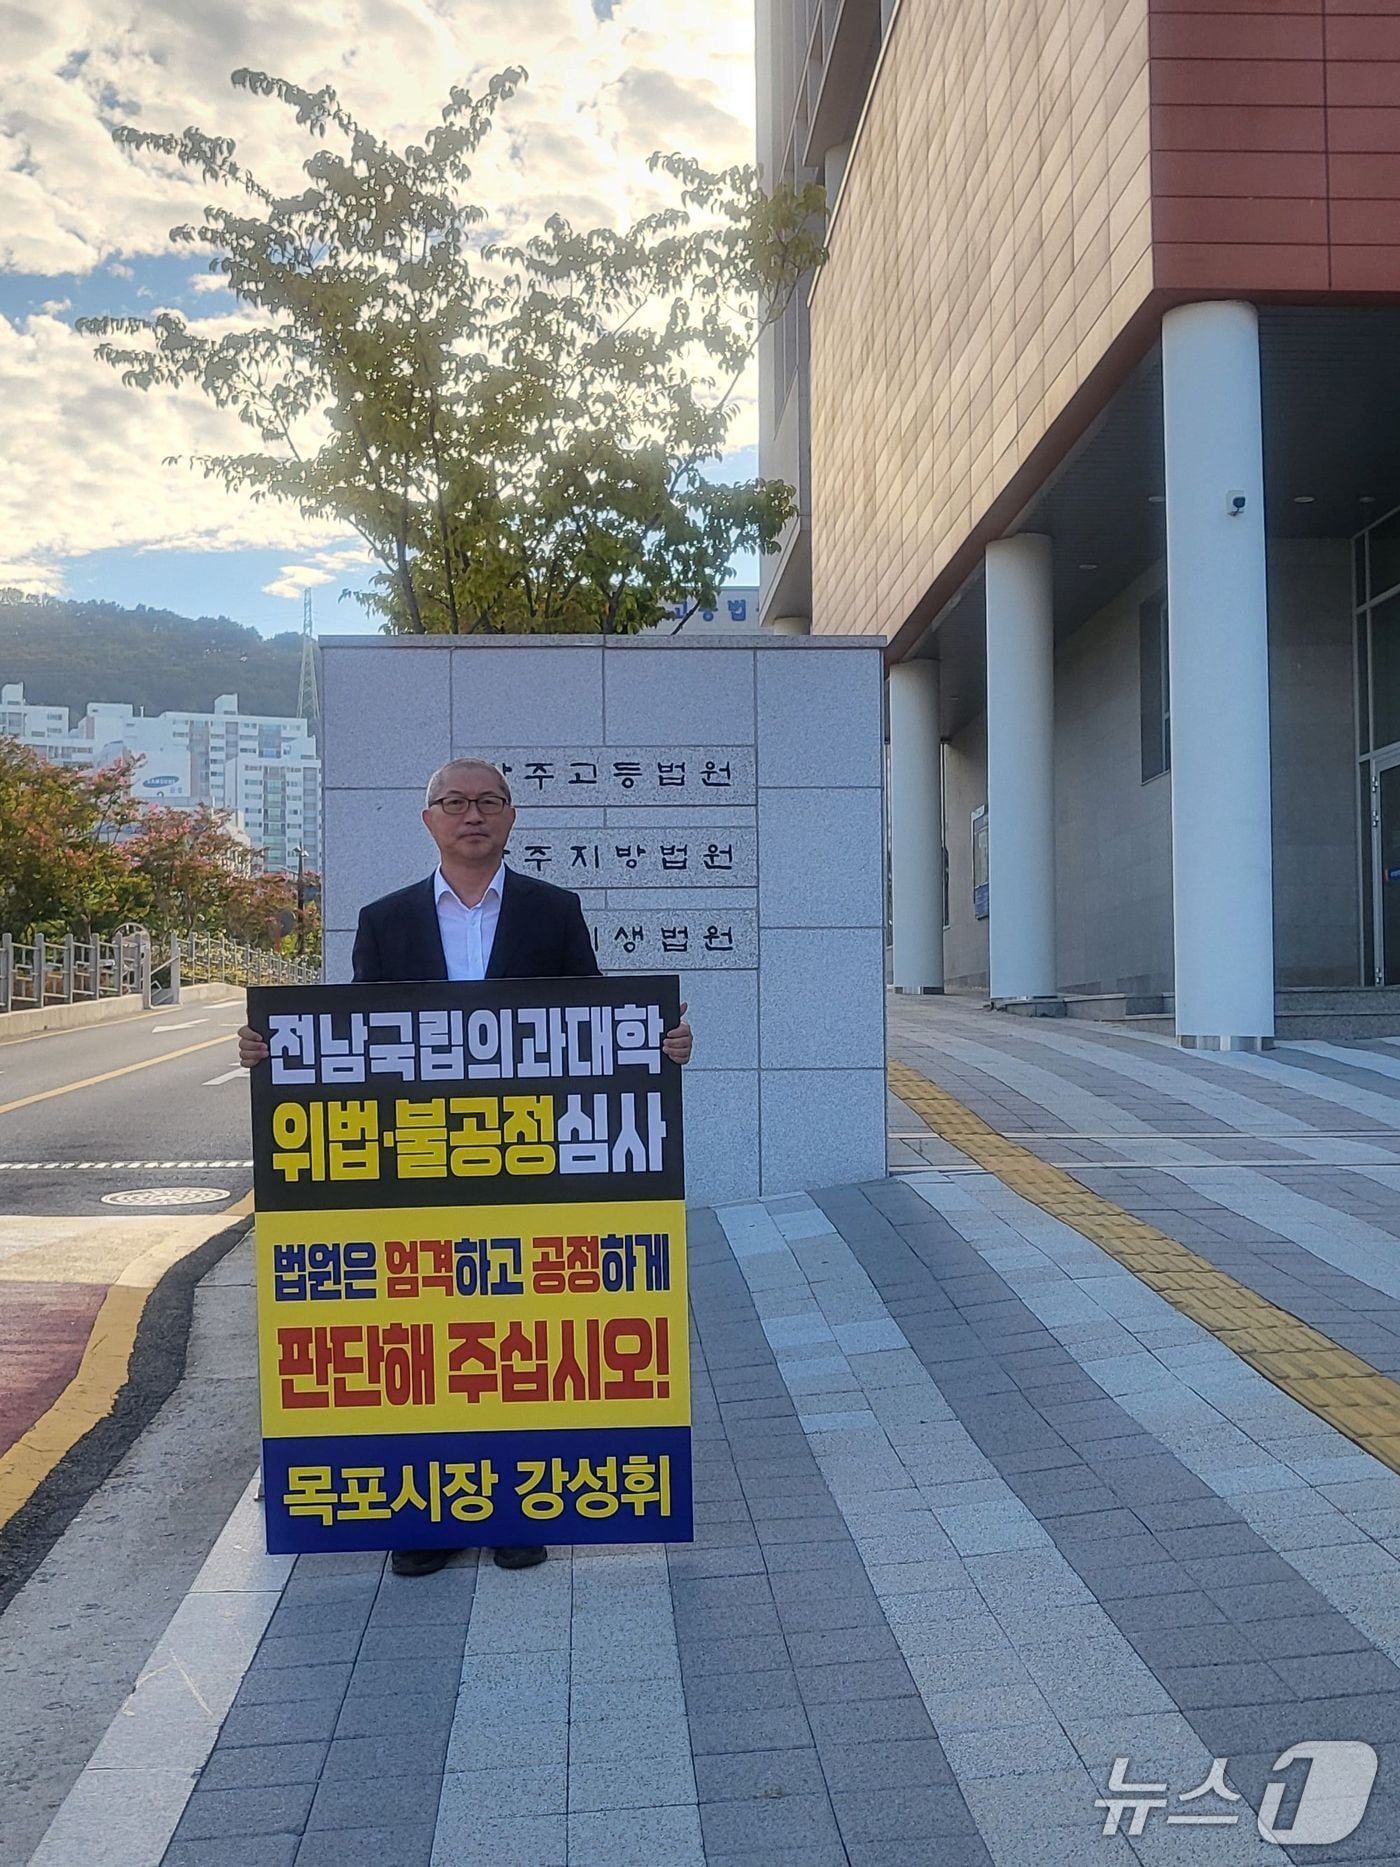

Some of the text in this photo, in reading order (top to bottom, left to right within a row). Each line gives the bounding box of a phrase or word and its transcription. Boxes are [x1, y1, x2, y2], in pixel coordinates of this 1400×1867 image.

[502, 844, 734, 872] 주지방법원
[593, 925, 734, 953] 생법원
[268, 1003, 665, 1085] 전남국립의과대학
[273, 1233, 671, 1301] 법원은 엄격하고 공정하게
[276, 1316, 671, 1410] 판단해 주십시오!
[282, 1454, 671, 1526] 목포시장 강성휘
